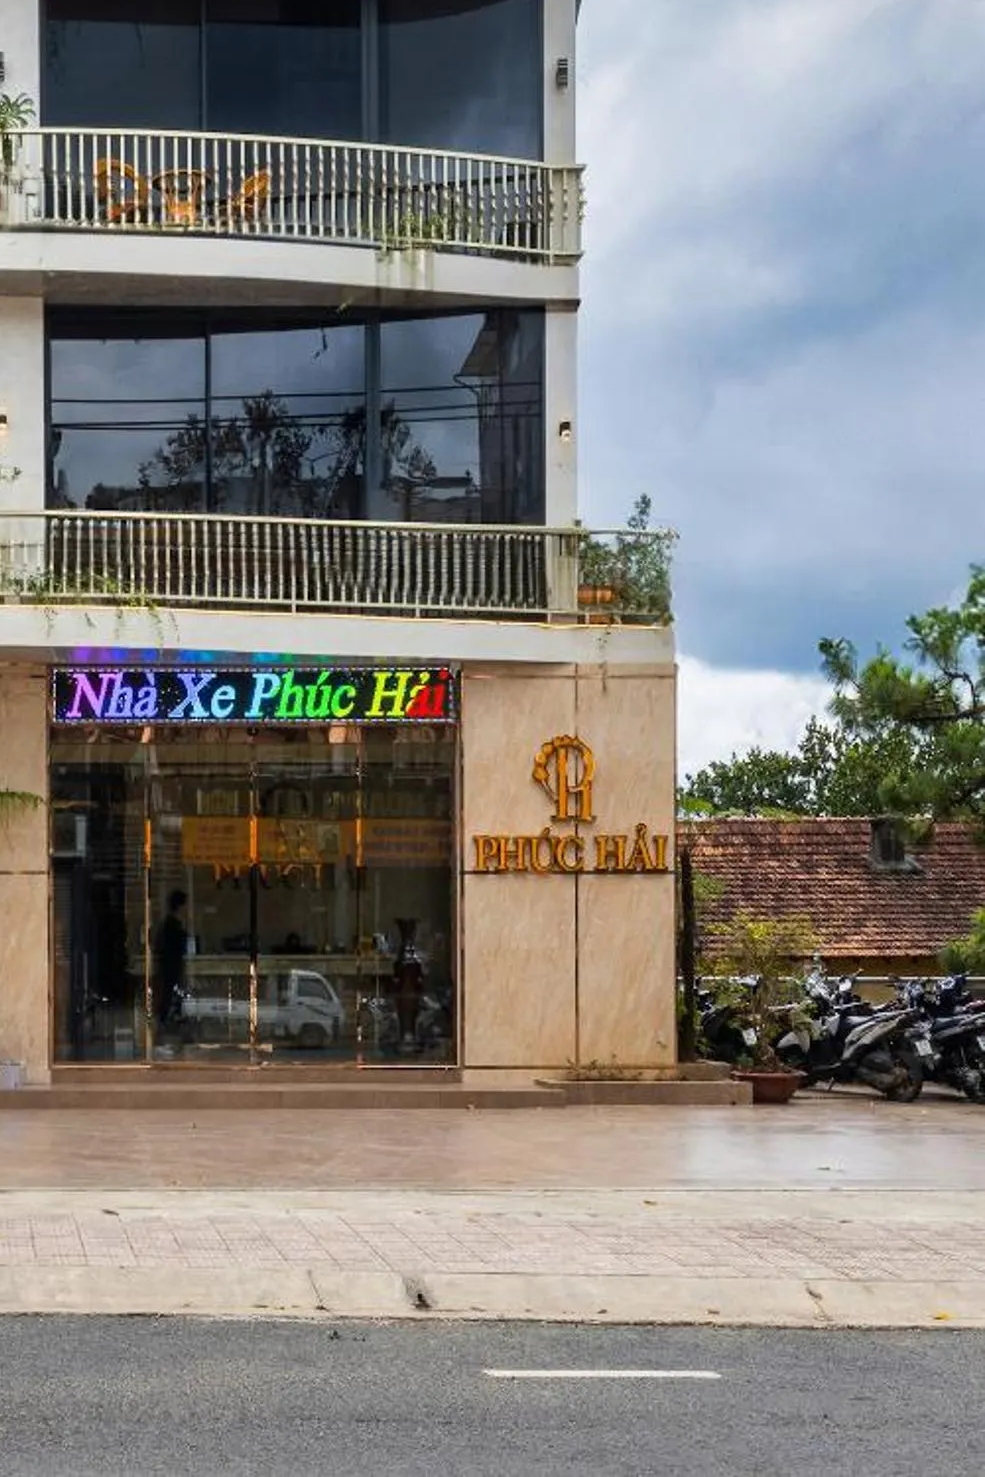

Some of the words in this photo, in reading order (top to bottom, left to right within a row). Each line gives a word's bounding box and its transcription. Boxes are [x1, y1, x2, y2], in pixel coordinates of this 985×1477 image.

[66, 671, 159, 719] Nhà
[168, 671, 236, 718] Xe
[245, 669, 357, 719] Phúc
[473, 826, 585, 874] PHÚC
[594, 823, 669, 873] HẢI
